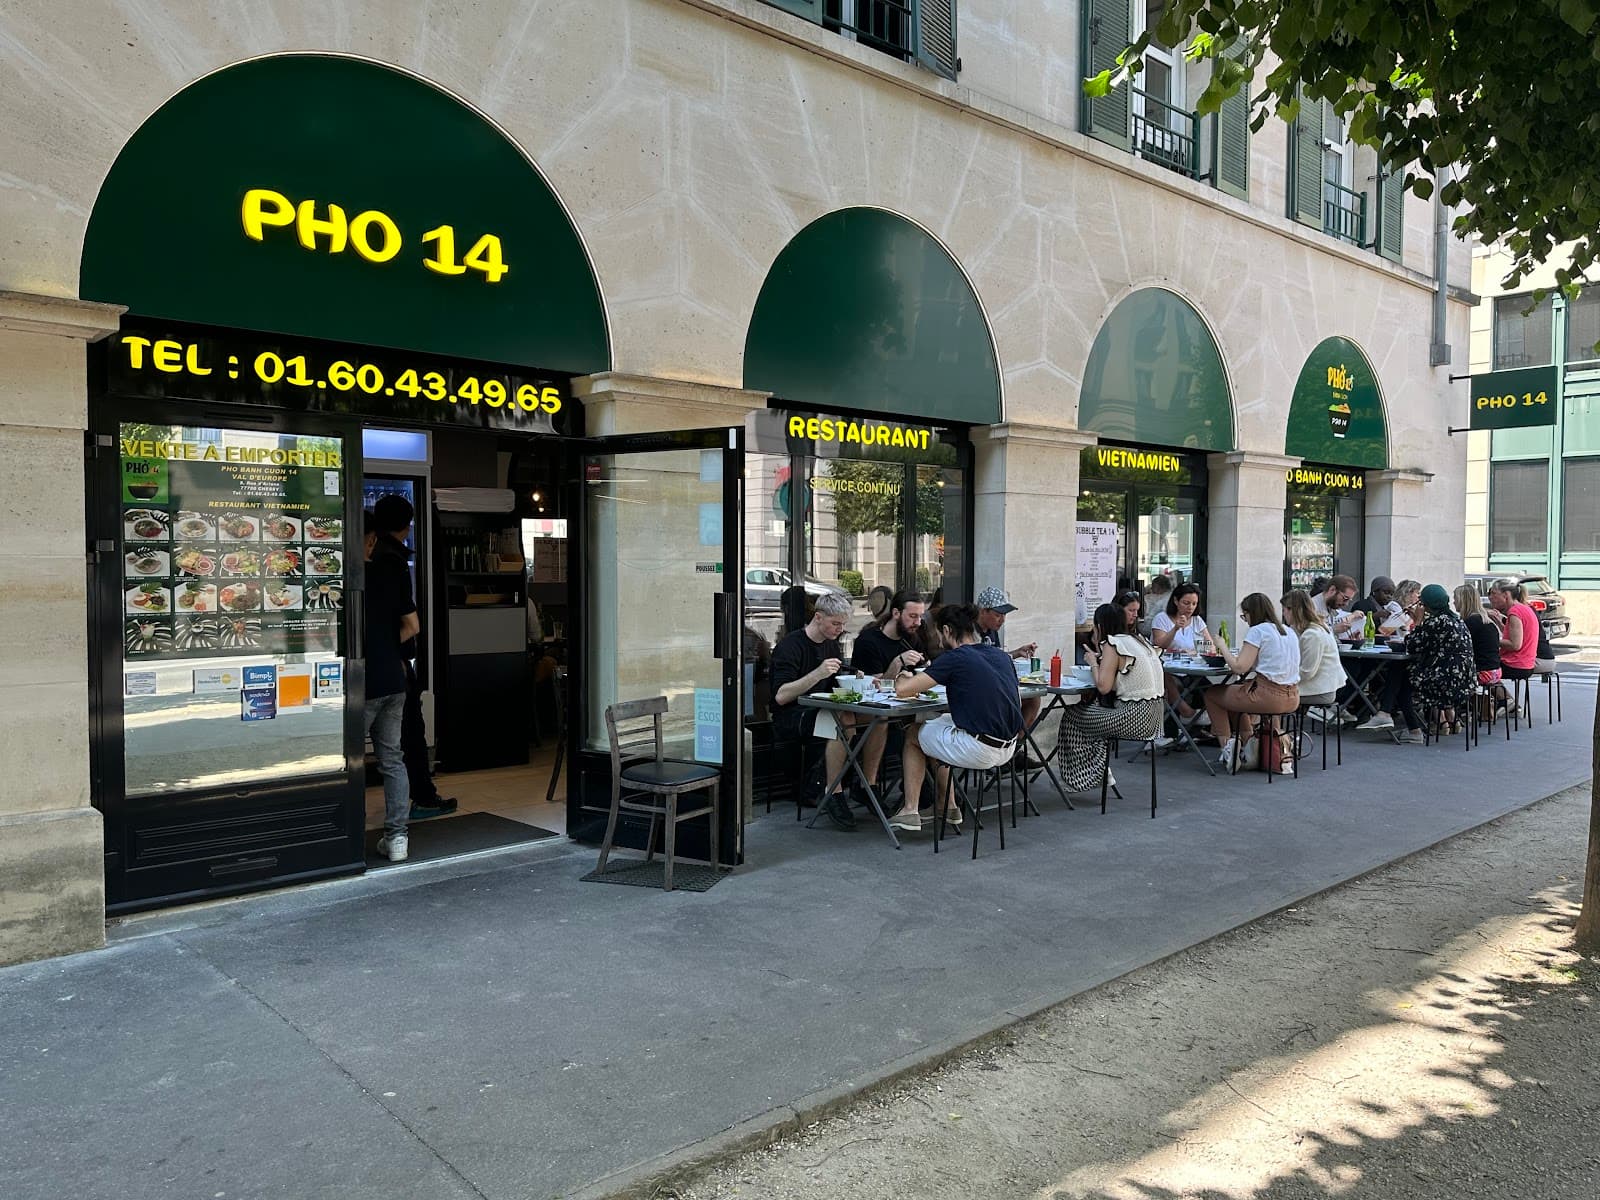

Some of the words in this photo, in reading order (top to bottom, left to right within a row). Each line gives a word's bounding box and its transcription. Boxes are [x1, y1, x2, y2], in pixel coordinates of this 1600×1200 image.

[242, 189, 402, 263] PHO
[422, 225, 509, 283] 14
[122, 336, 211, 375] TEL
[254, 352, 562, 414] 01.60.43.49.65
[1476, 394, 1517, 410] PHO
[1522, 391, 1548, 405] 14
[789, 416, 931, 449] RESTAURANT
[123, 440, 198, 460] VENTE
[226, 446, 340, 467] EMPORTER
[1098, 449, 1180, 472] VIETNAMIEN
[810, 477, 855, 493] SERVICE
[857, 481, 900, 496] CONTINU
[1295, 469, 1322, 484] BANH
[1324, 472, 1350, 488] CUON
[1351, 475, 1363, 489] 14
[208, 501, 261, 509] RESTAURANT
